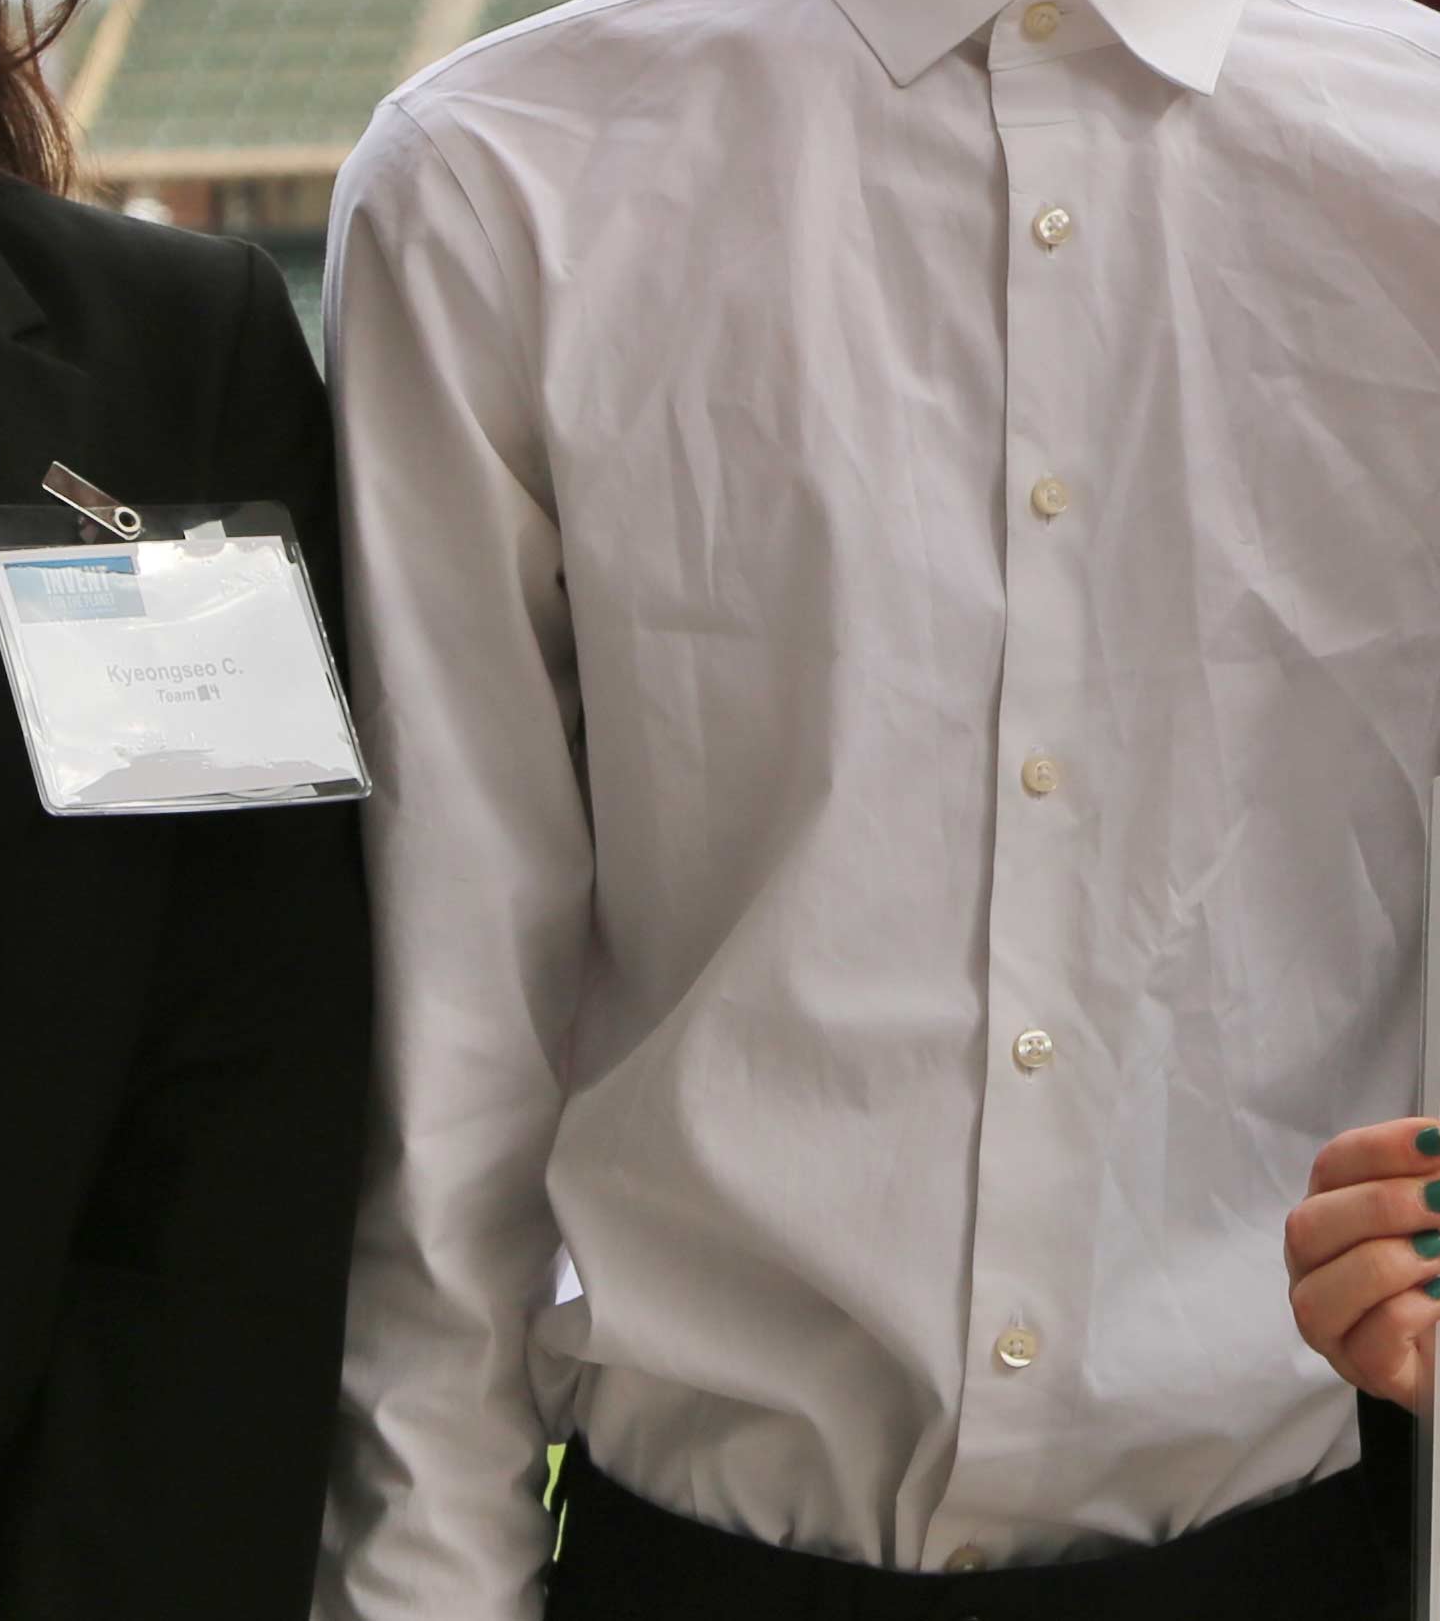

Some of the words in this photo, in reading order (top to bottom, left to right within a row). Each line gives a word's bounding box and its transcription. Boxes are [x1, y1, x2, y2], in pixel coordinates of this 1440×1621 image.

[41, 565, 111, 595] INVENT
[106, 663, 217, 687] Kyeongseo
[222, 657, 244, 675] C.
